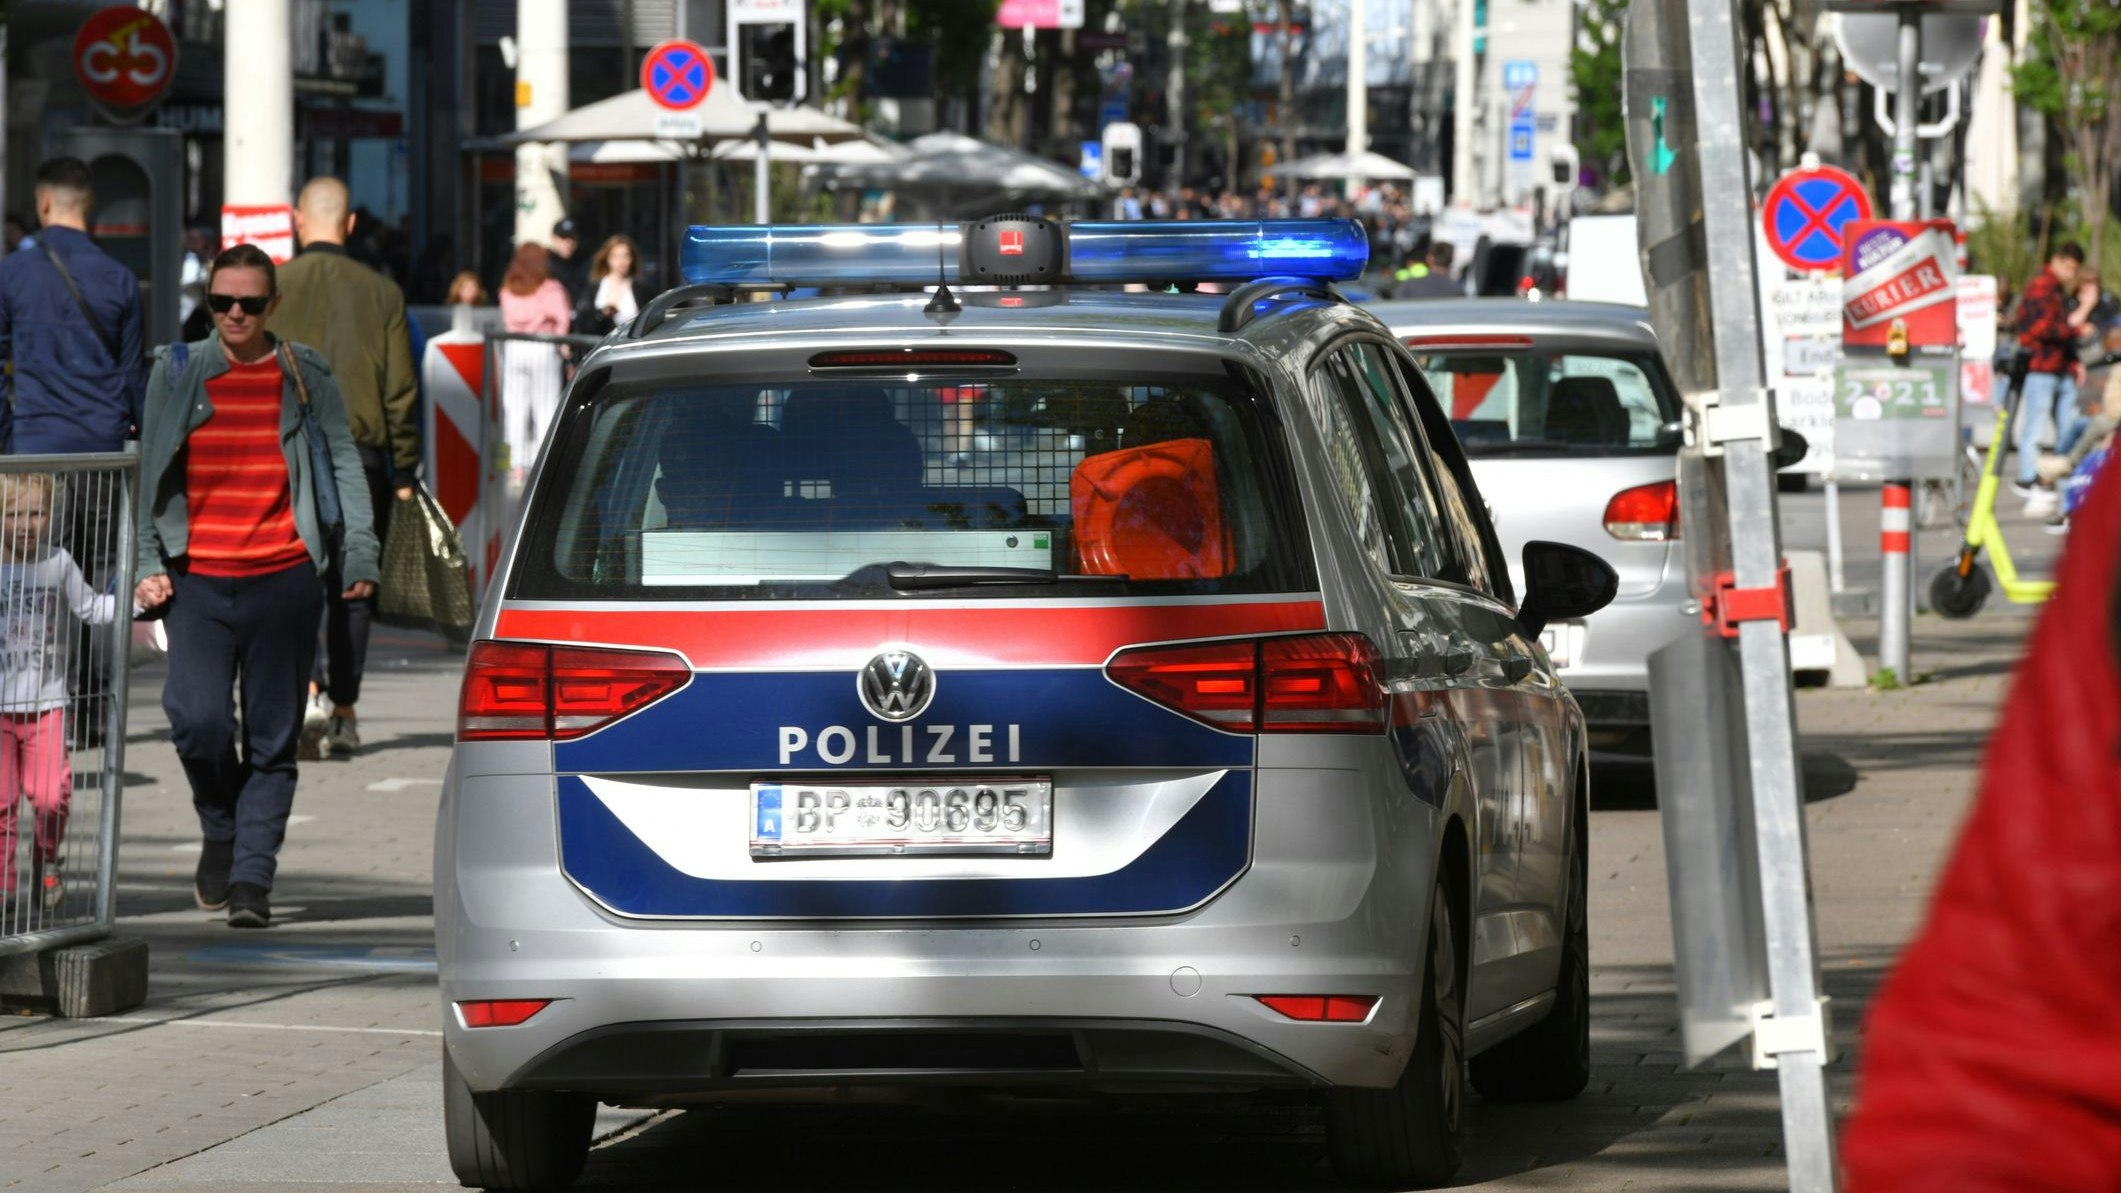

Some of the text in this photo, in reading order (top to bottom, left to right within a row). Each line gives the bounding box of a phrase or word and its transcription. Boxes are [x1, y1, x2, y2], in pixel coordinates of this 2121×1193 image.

[1848, 265, 1942, 318] KURIER
[778, 724, 1020, 765] POLIZEI
[763, 788, 1028, 833] A BP 90695
